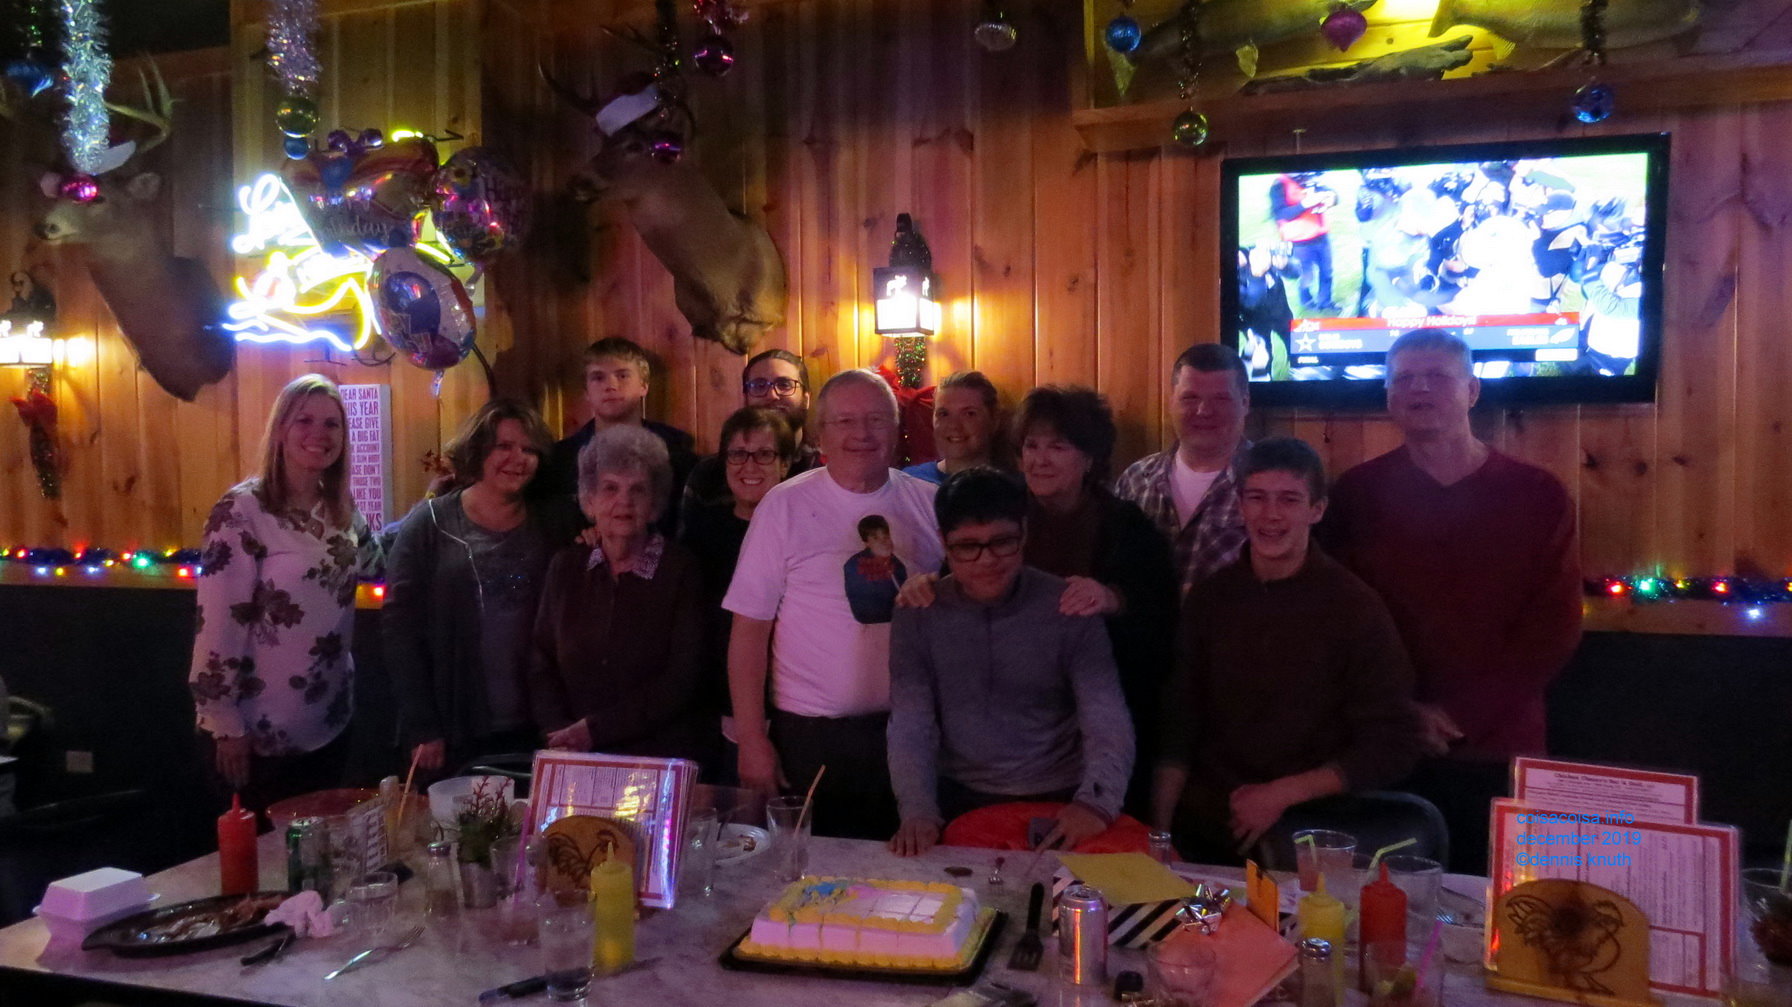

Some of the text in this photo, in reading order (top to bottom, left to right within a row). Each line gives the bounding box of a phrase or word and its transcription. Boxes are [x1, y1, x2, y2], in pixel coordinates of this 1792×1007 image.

[358, 387, 378, 400] SANTA
[344, 401, 378, 415] HIS YEAR
[348, 416, 379, 429] EASE GIVE
[357, 430, 368, 442] BIG
[369, 430, 380, 441] FAT
[368, 487, 381, 499] YOU
